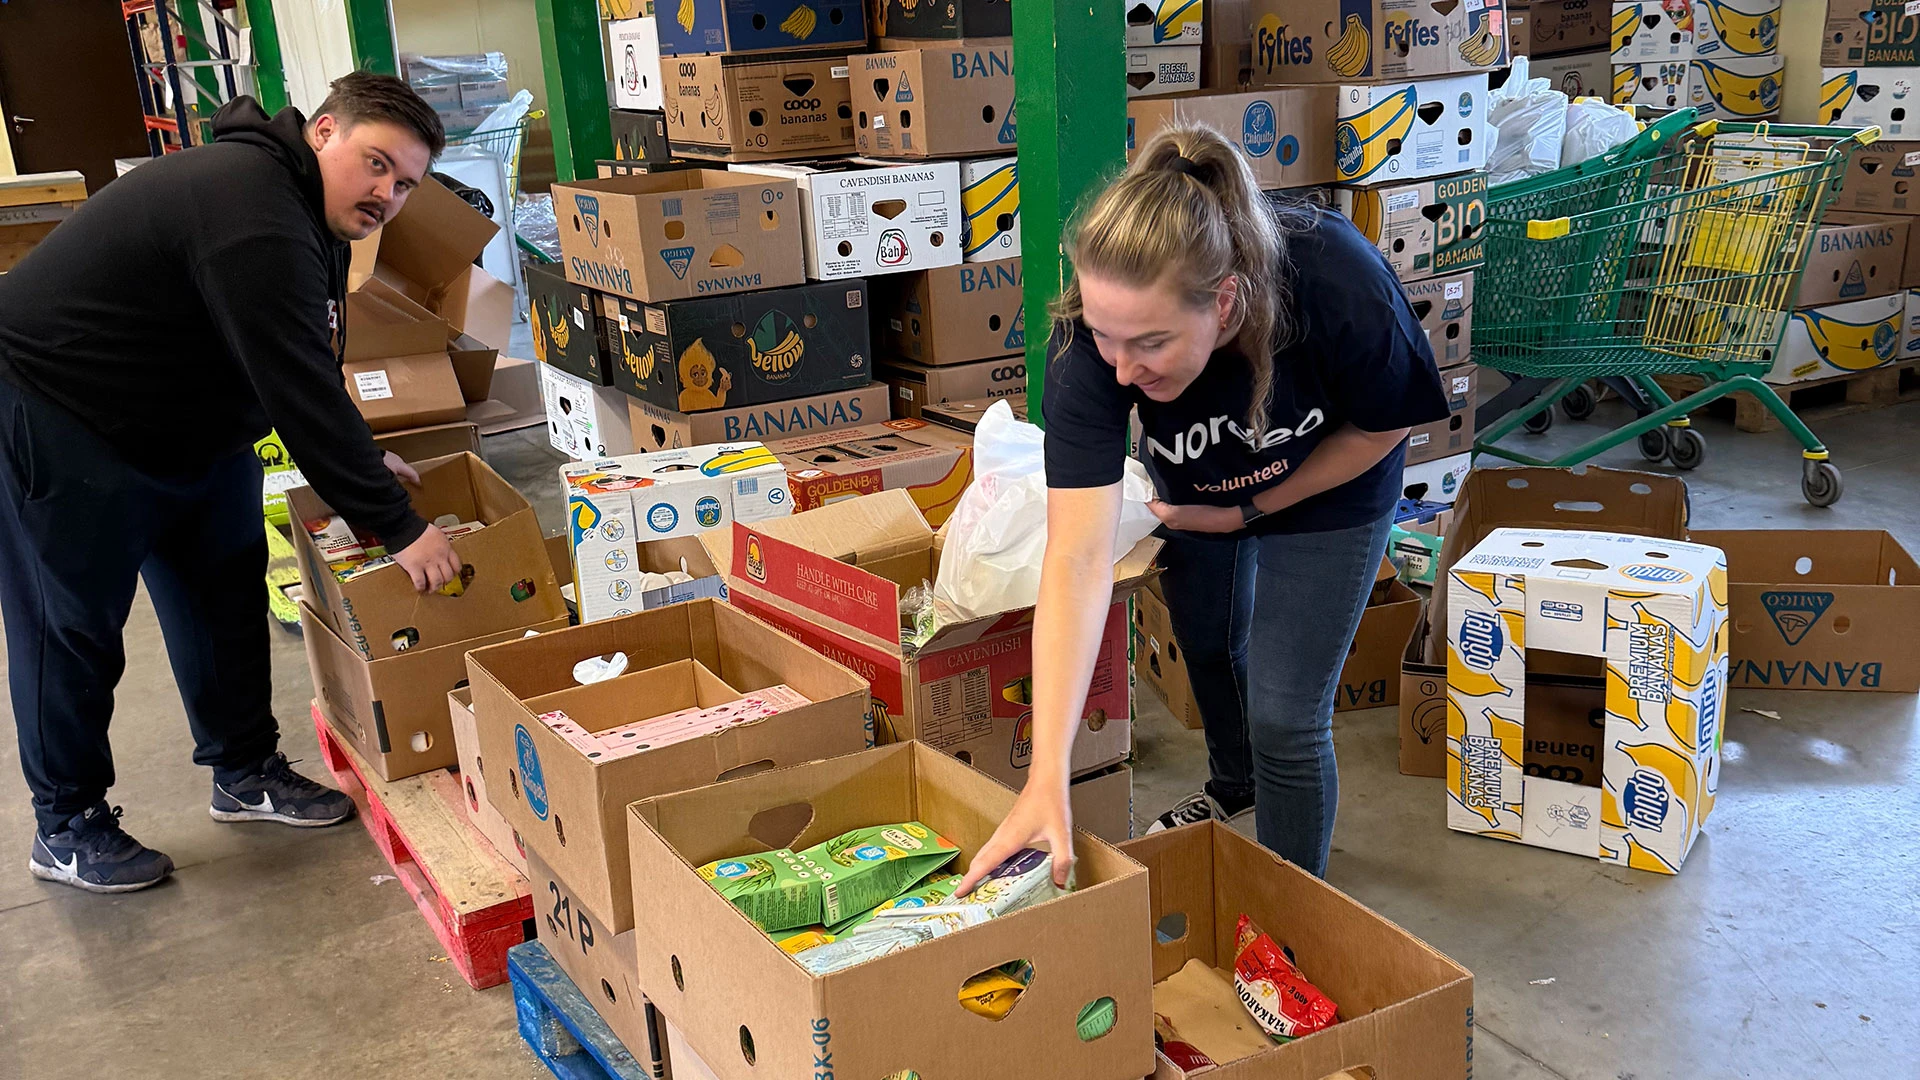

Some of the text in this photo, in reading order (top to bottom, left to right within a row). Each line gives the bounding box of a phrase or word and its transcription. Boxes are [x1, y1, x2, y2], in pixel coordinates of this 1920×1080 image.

[1869, 11, 1919, 44] BIO
[865, 56, 897, 71] BANANAS
[1258, 25, 1313, 74] fyffes
[1867, 49, 1915, 62] BANANA
[678, 62, 696, 80] coop
[1159, 71, 1196, 84] BANANAS
[678, 82, 701, 97] bananas
[783, 98, 822, 112] coop
[780, 111, 828, 126] bananas
[1243, 131, 1275, 145] Chiquita
[840, 171, 935, 188] CAVENDISH BANANAS
[1438, 177, 1487, 199] GOLDEN
[1437, 199, 1486, 246] BIO
[1436, 245, 1484, 268] BANANA
[1820, 227, 1894, 253] BANANAS
[571, 256, 633, 294] BANANAS
[697, 272, 762, 292] BANANAS
[723, 397, 863, 441] BANANAS
[1193, 458, 1289, 492] Volunteer
[796, 562, 879, 607] HANDLE WITH CARE
[1766, 593, 1828, 607] AMIGO
[947, 636, 1022, 669] CAVENDISH
[1460, 609, 1502, 672] Tango
[822, 643, 877, 680] BANANAS
[1628, 621, 1651, 700] PREMIUM
[1646, 623, 1668, 703] BANANAS
[1467, 735, 1485, 808] BANANAS
[1484, 736, 1502, 810] PREMIUM
[1625, 769, 1666, 833] Tango
